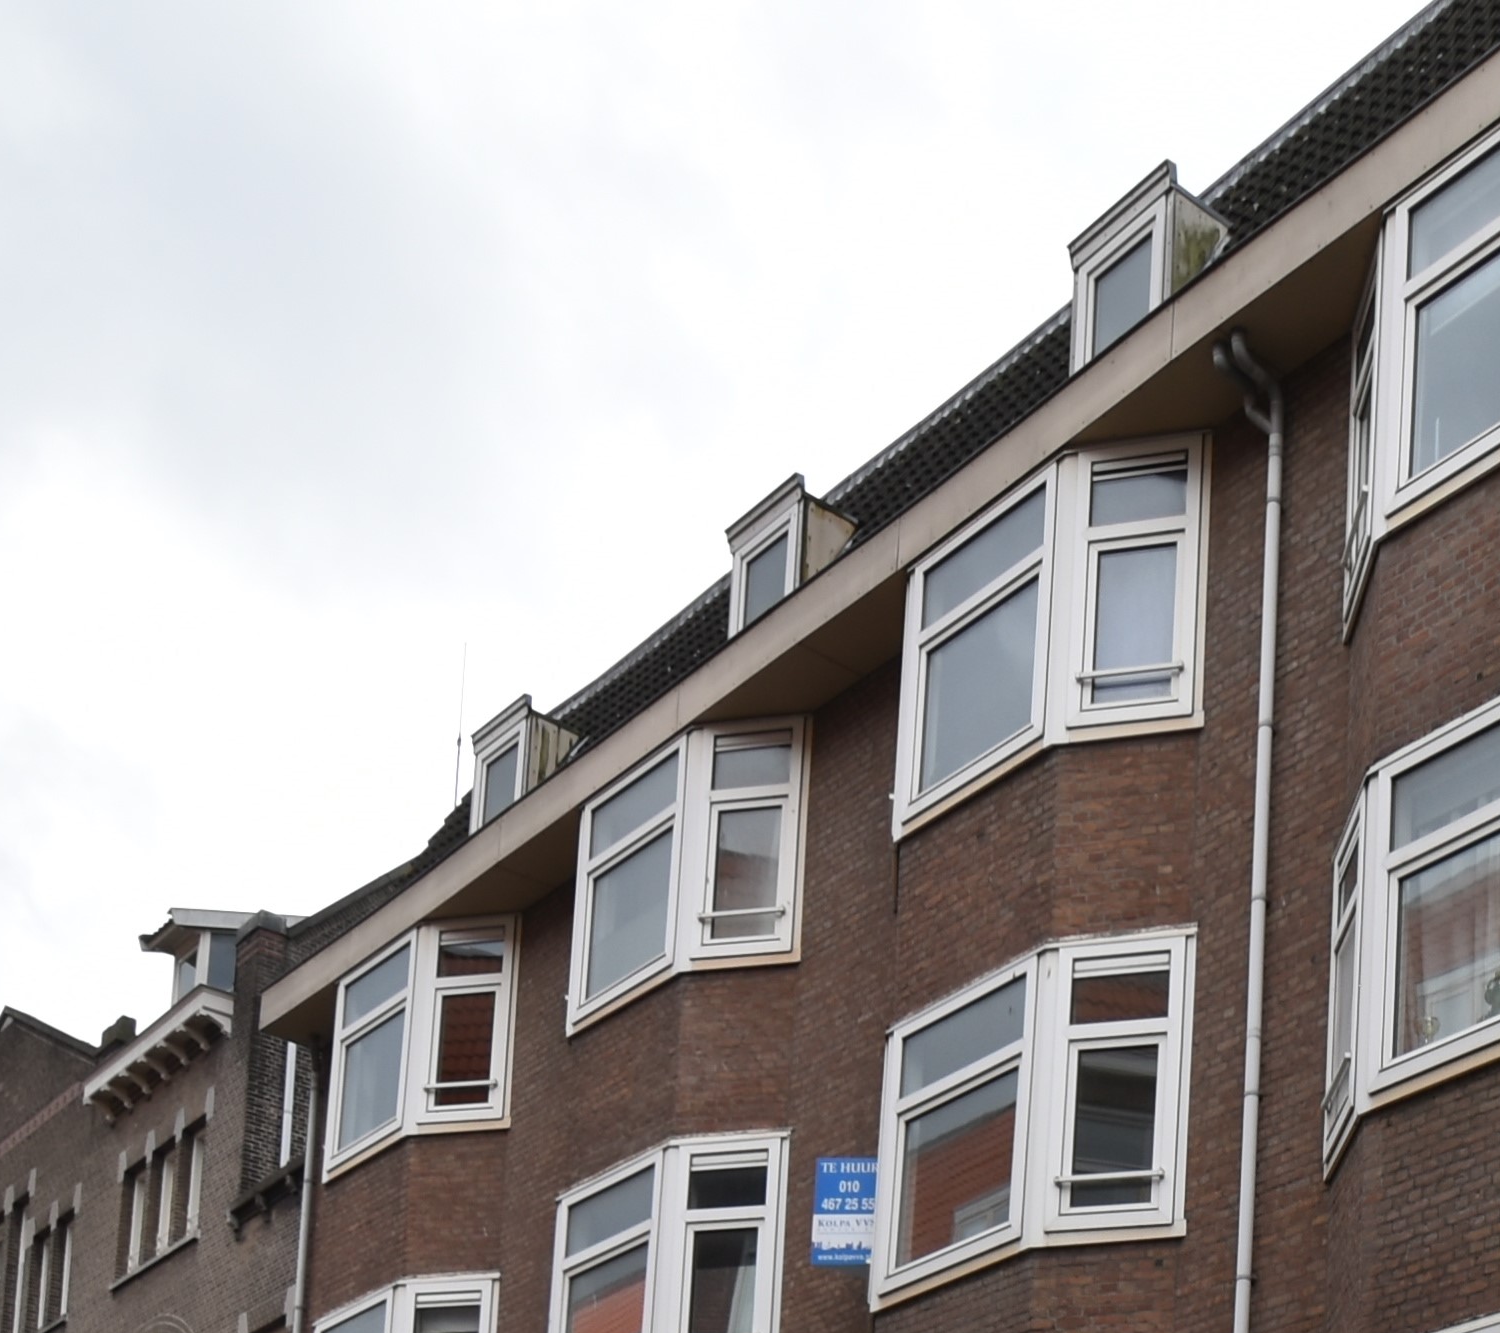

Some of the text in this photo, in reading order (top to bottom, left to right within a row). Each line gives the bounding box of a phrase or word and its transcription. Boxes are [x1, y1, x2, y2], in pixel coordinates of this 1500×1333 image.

[821, 1162, 837, 1173] TE
[839, 1180, 860, 1193] 010
[821, 1198, 841, 1210] 467
[844, 1198, 858, 1210] 25
